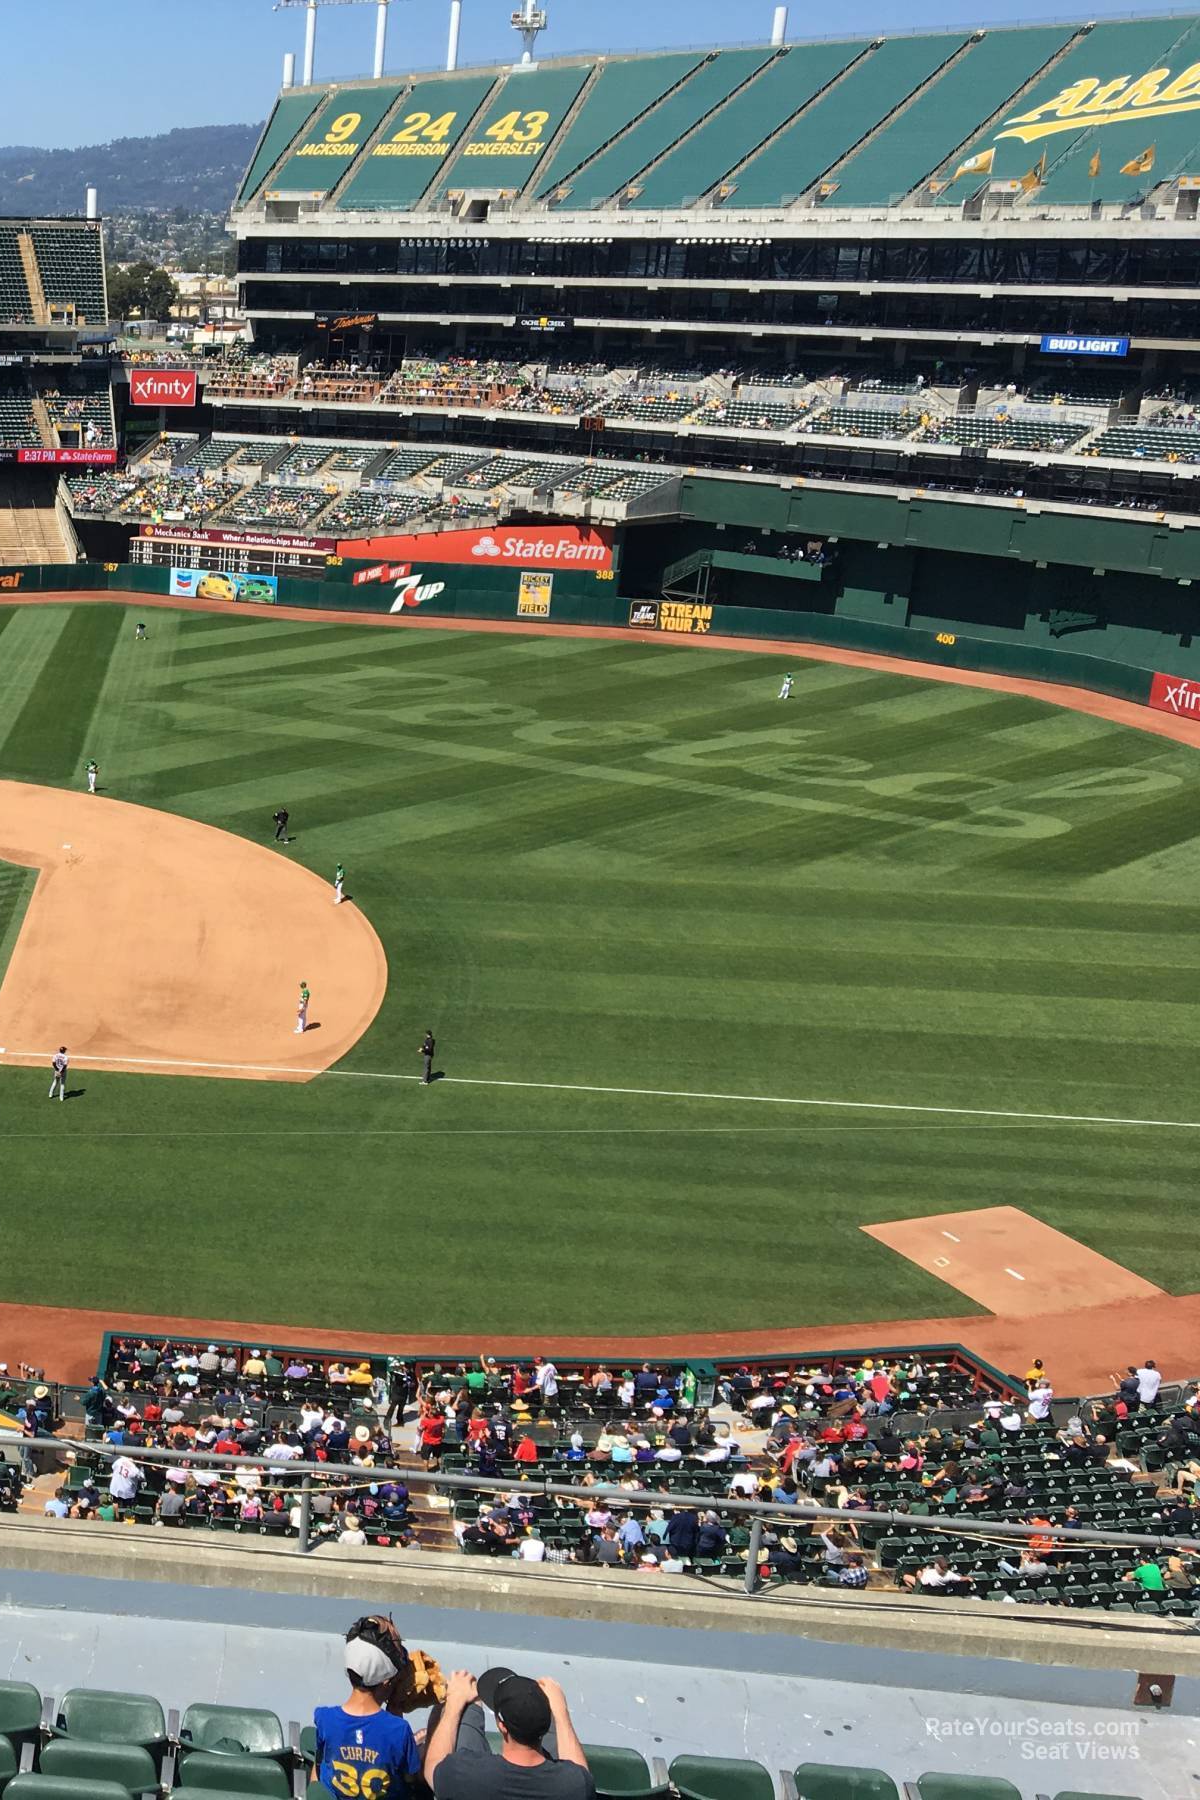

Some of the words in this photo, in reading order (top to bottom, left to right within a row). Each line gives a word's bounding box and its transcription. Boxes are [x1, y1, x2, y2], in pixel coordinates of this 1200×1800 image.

[325, 112, 361, 142] 9
[391, 111, 457, 142] 24
[485, 111, 549, 141] 43
[296, 143, 359, 156] JACKSON
[372, 143, 450, 156] HENDERSON
[464, 142, 546, 156] ECKERSLEY
[1049, 338, 1078, 351] BUD
[1079, 339, 1119, 352] LIGHT
[135, 377, 192, 399] xfinity
[24, 451, 41, 461] 2:37
[43, 451, 56, 461] PM
[103, 563, 119, 572] 367
[326, 556, 343, 566] 362
[367, 567, 384, 580] MORE
[389, 566, 405, 578] WITH
[523, 575, 550, 583] RICKEY
[595, 570, 614, 581] 388
[520, 604, 547, 614] FIELD
[661, 602, 713, 619] STREAM
[633, 612, 655, 620] TEAMS
[660, 617, 693, 632] YOUR
[936, 632, 956, 645] 400
[340, 1746, 380, 1765] CURRY
